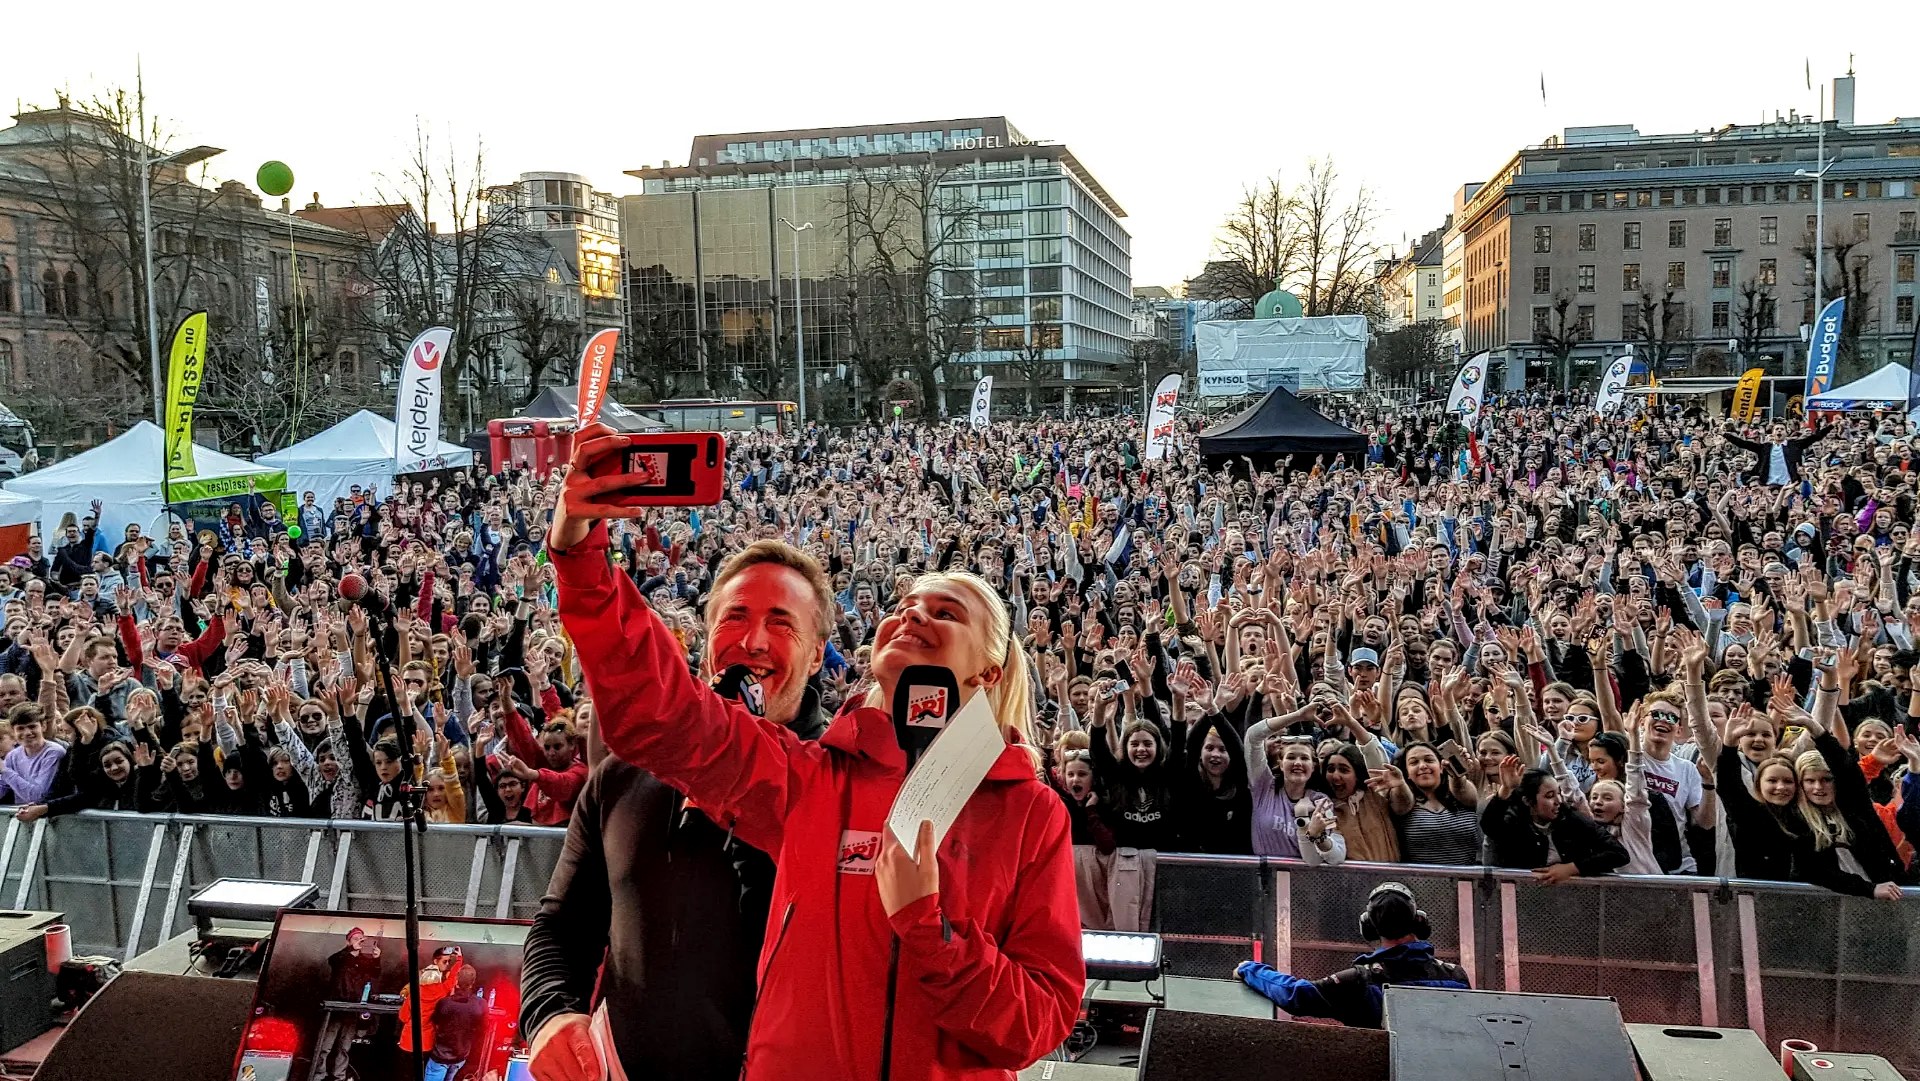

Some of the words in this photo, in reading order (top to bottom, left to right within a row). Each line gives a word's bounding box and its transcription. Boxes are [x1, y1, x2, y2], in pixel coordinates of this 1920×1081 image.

[954, 135, 1004, 150] HOTEL
[1816, 316, 1838, 375] Budget
[584, 344, 606, 416] VARMEFAG
[407, 377, 434, 457] viaplay
[1124, 811, 1161, 823] adidas
